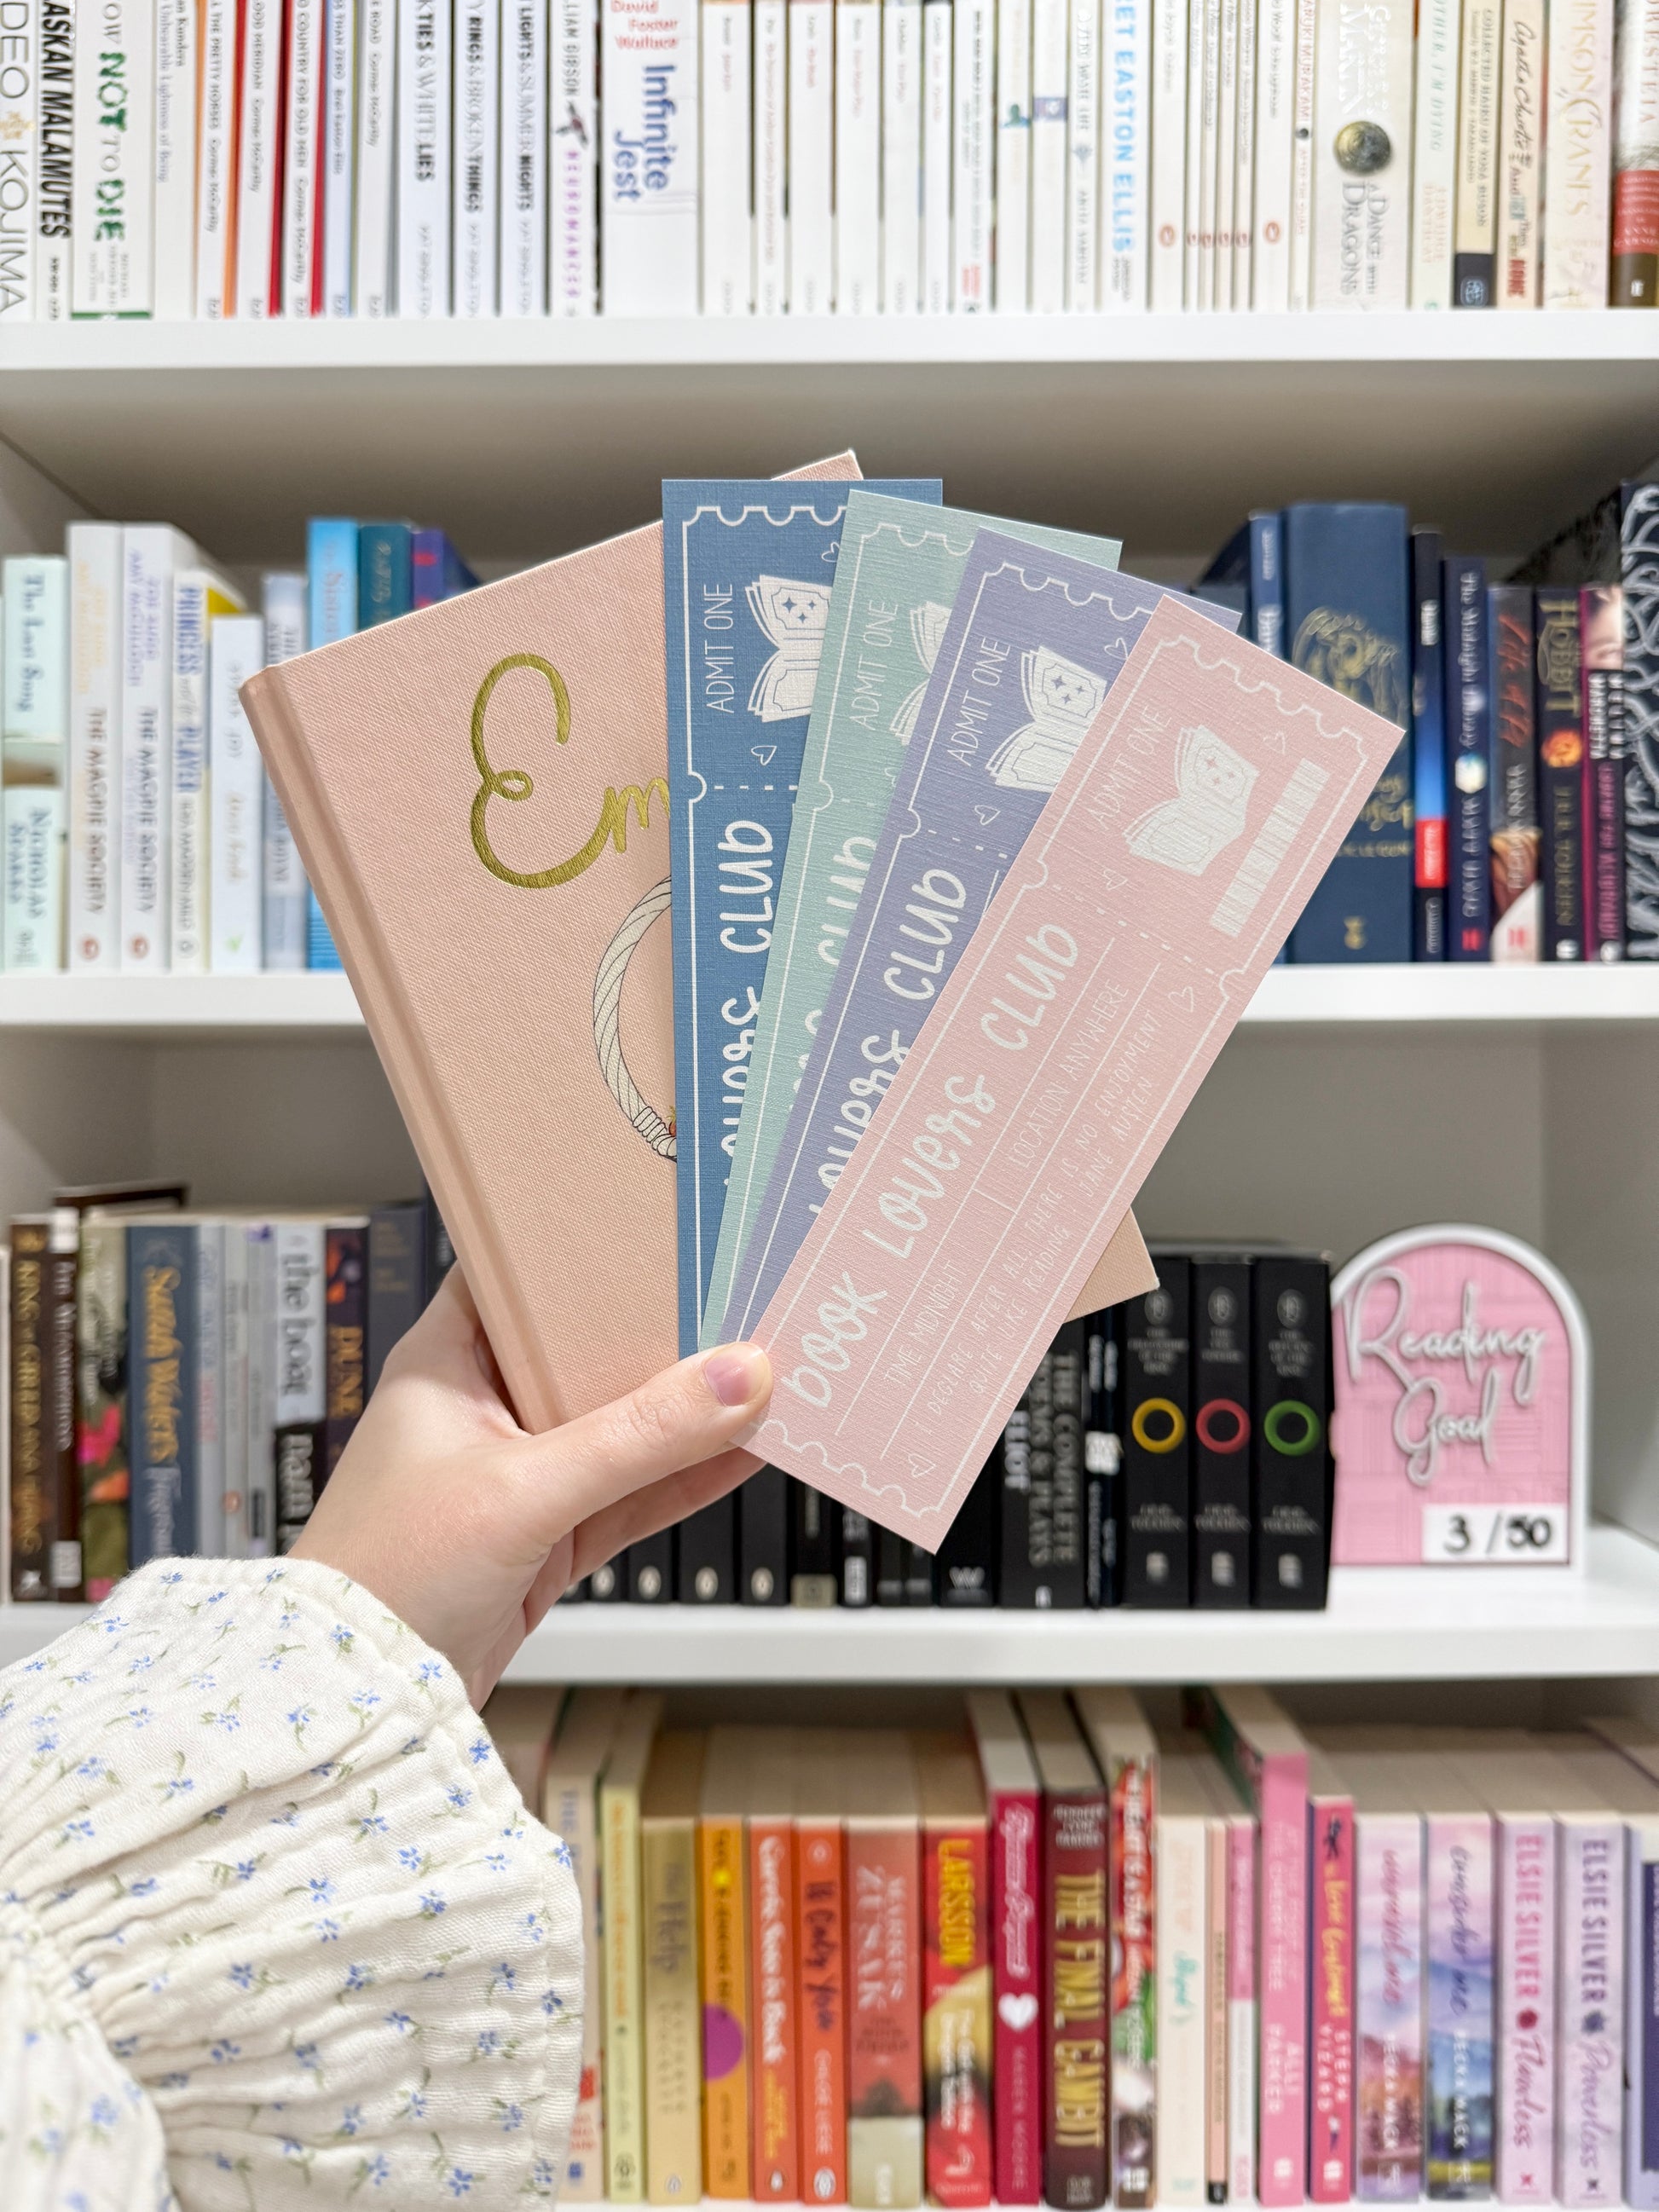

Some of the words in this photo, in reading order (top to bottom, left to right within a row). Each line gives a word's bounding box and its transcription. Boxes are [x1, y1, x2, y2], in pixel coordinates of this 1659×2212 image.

[41, 0, 72, 84] ASKAN
[416, 14, 435, 52] TIES
[465, 17, 484, 64] RINGS
[517, 8, 535, 61] LIGHTS
[1113, 0, 1136, 38] ET
[1512, 21, 1537, 84] Agatha
[98, 52, 128, 132] NOT
[563, 44, 581, 97] GIBSON
[1113, 50, 1136, 162] EASTON
[641, 64, 678, 190] Infinite
[1511, 85, 1535, 149] Christie
[1558, 98, 1604, 217] CRANES
[40, 90, 72, 240] MALAMUTES
[415, 143, 436, 182] LIES
[614, 129, 646, 204] Jest
[0, 151, 29, 314] KOJIMA
[94, 179, 125, 242] DIE
[1112, 173, 1136, 251] ELLIS
[1340, 182, 1367, 296] DRAGONS
[175, 586, 204, 677] PRINCESS
[704, 581, 734, 632] ONE
[863, 599, 900, 650] ONE
[1459, 609, 1484, 683] Midnight
[706, 640, 735, 713] ADMIT
[849, 656, 885, 731] ADMIT
[1540, 599, 1581, 718] HOBBIT
[86, 707, 108, 742] THE
[136, 707, 159, 742] THE
[947, 690, 993, 766] ADMIT
[971, 635, 1013, 687] ONE
[86, 748, 108, 827] MAGPIE
[136, 748, 159, 827] MAGPIE
[175, 725, 204, 794] PLAYER
[1084, 753, 1142, 830] ADMIT
[1126, 702, 1172, 758] ONE
[86, 834, 108, 916] SOCIETY
[136, 834, 159, 915] SOCIETY
[1056, 976, 1130, 1083] ANYWHERE
[924, 1342, 975, 1415] DECLARE
[968, 1284, 1008, 1336] AFTER
[1023, 1181, 1066, 1237] THERE
[1057, 1156, 1080, 1178] IS
[1073, 1122, 1100, 1151] NO
[1092, 1008, 1165, 1118] ENJOYMENT
[965, 1343, 1005, 1394] QUITE
[995, 1298, 1029, 1340] LIKE
[1019, 1222, 1072, 1296] READING
[1076, 1146, 1116, 1198] JANE
[1108, 1075, 1159, 1143] AUSTEN
[286, 1252, 322, 1311] the
[907, 1259, 968, 1347] MIDNIGHT
[283, 1316, 317, 1396] boat
[329, 1326, 363, 1418] DUNE
[1341, 1266, 1546, 1409] Reading
[145, 1359, 182, 1464] Waters
[1004, 1410, 1031, 1493] ELIOT
[1392, 1376, 1500, 1487] Goal
[1054, 1413, 1081, 1568] COMPLETE
[938, 1838, 976, 1967] LARSSON
[1055, 1870, 1106, 1932] THE
[1515, 1834, 1545, 1903] ELSIE
[1582, 1839, 1610, 1908] ELSIE
[1054, 1938, 1106, 2029] FINAL
[1514, 1909, 1542, 2001] SILVER
[1581, 1915, 1610, 2003] SILVER
[1054, 2038, 1106, 2148] GAMBIT
[1454, 2098, 1472, 2151] MACK
[1512, 2032, 1546, 2150] Flawless
[1579, 2039, 1615, 2169] Powerless
